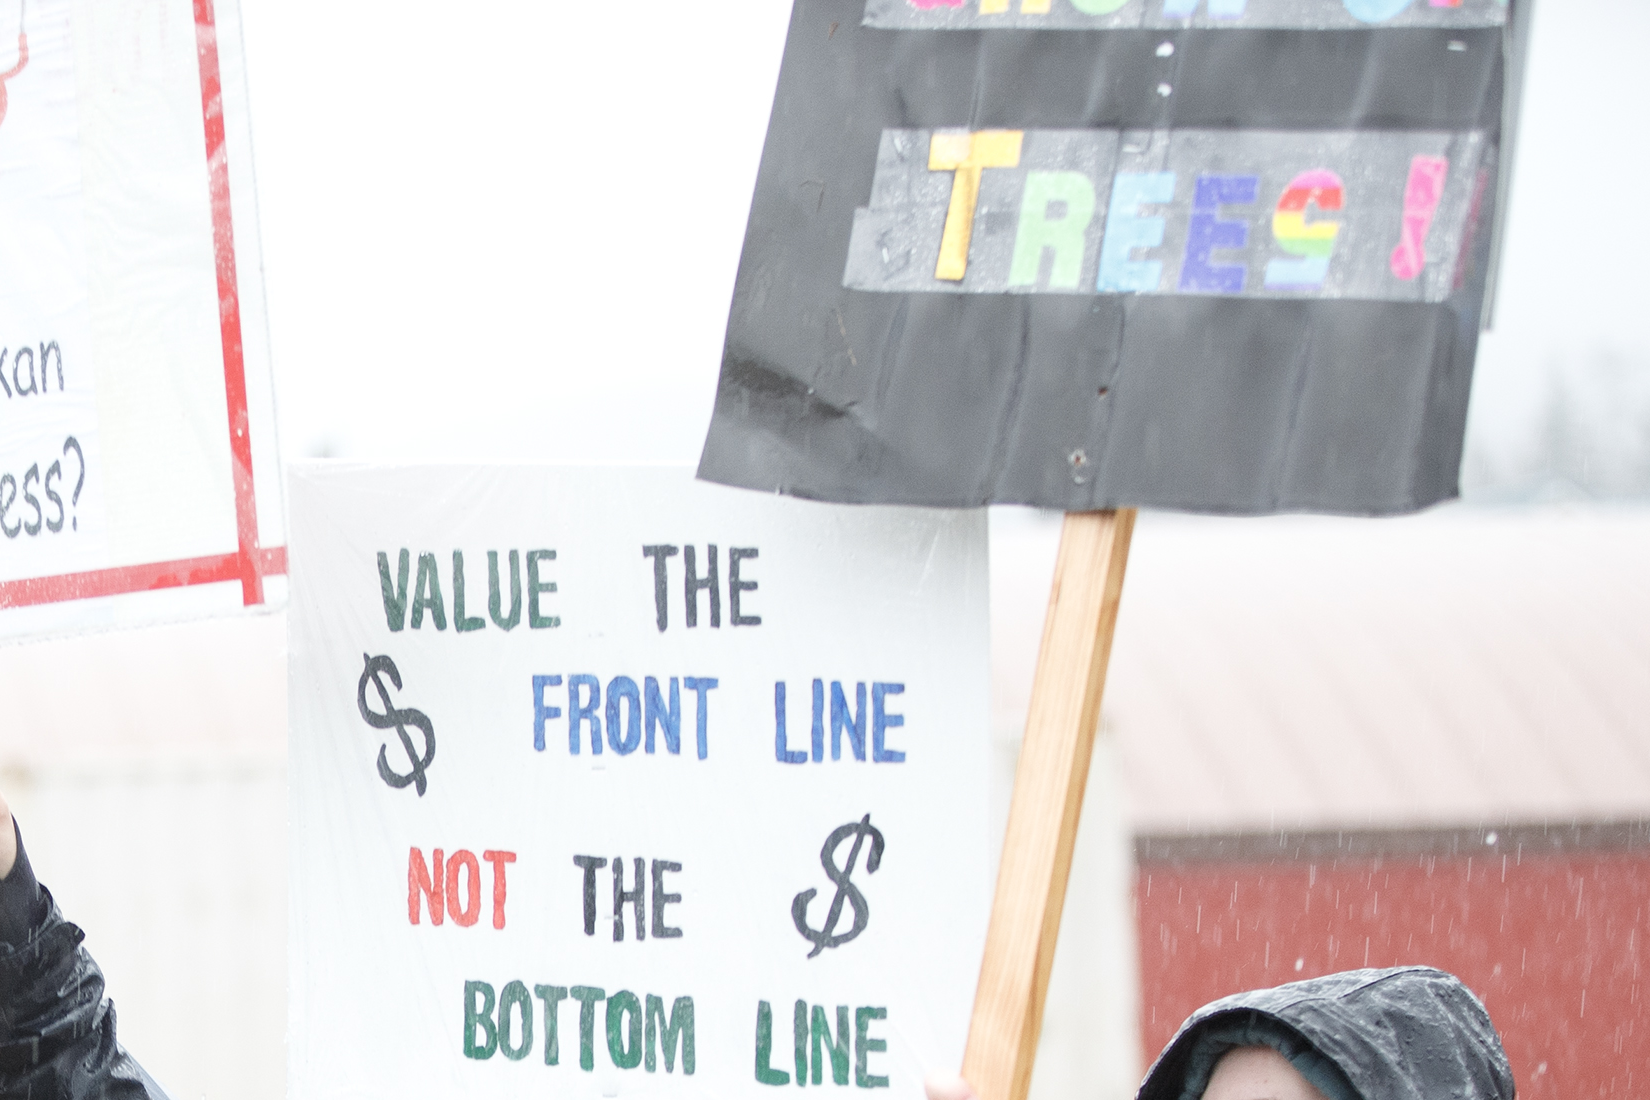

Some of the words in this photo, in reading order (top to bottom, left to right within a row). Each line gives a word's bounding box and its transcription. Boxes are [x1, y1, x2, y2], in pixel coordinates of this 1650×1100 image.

[377, 547, 561, 633] VALUE
[642, 544, 762, 633] THE
[357, 652, 437, 797] $
[532, 673, 719, 761] FRONT
[774, 678, 907, 764] LINE
[407, 846, 517, 931] NOT
[572, 854, 684, 942] THE
[791, 812, 886, 960] $
[463, 979, 696, 1076] BOTTOM
[755, 998, 891, 1089] LINE
